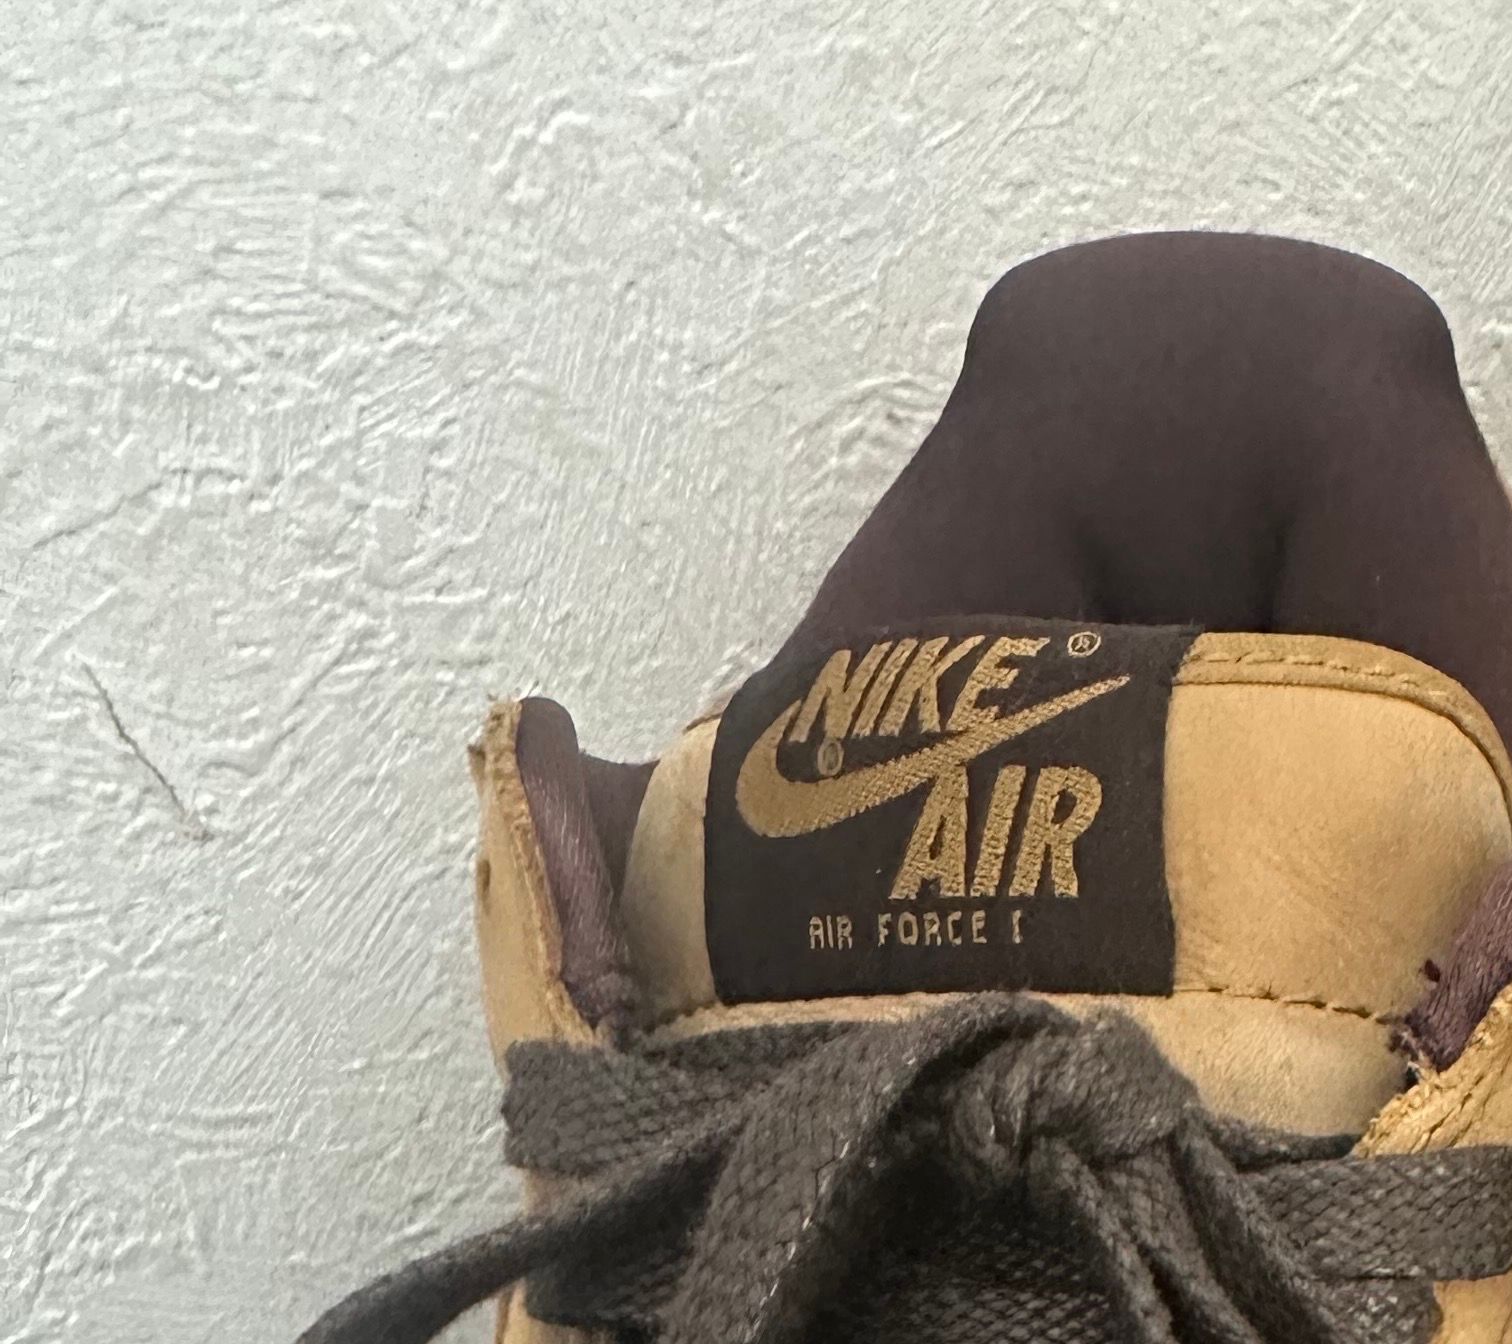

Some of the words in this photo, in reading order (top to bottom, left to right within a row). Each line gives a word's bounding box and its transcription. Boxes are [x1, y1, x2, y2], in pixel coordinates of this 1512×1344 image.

[788, 635, 1051, 743] NIKE
[889, 764, 1103, 900] AIR
[809, 916, 853, 951] AIR
[877, 911, 988, 947] FORCE
